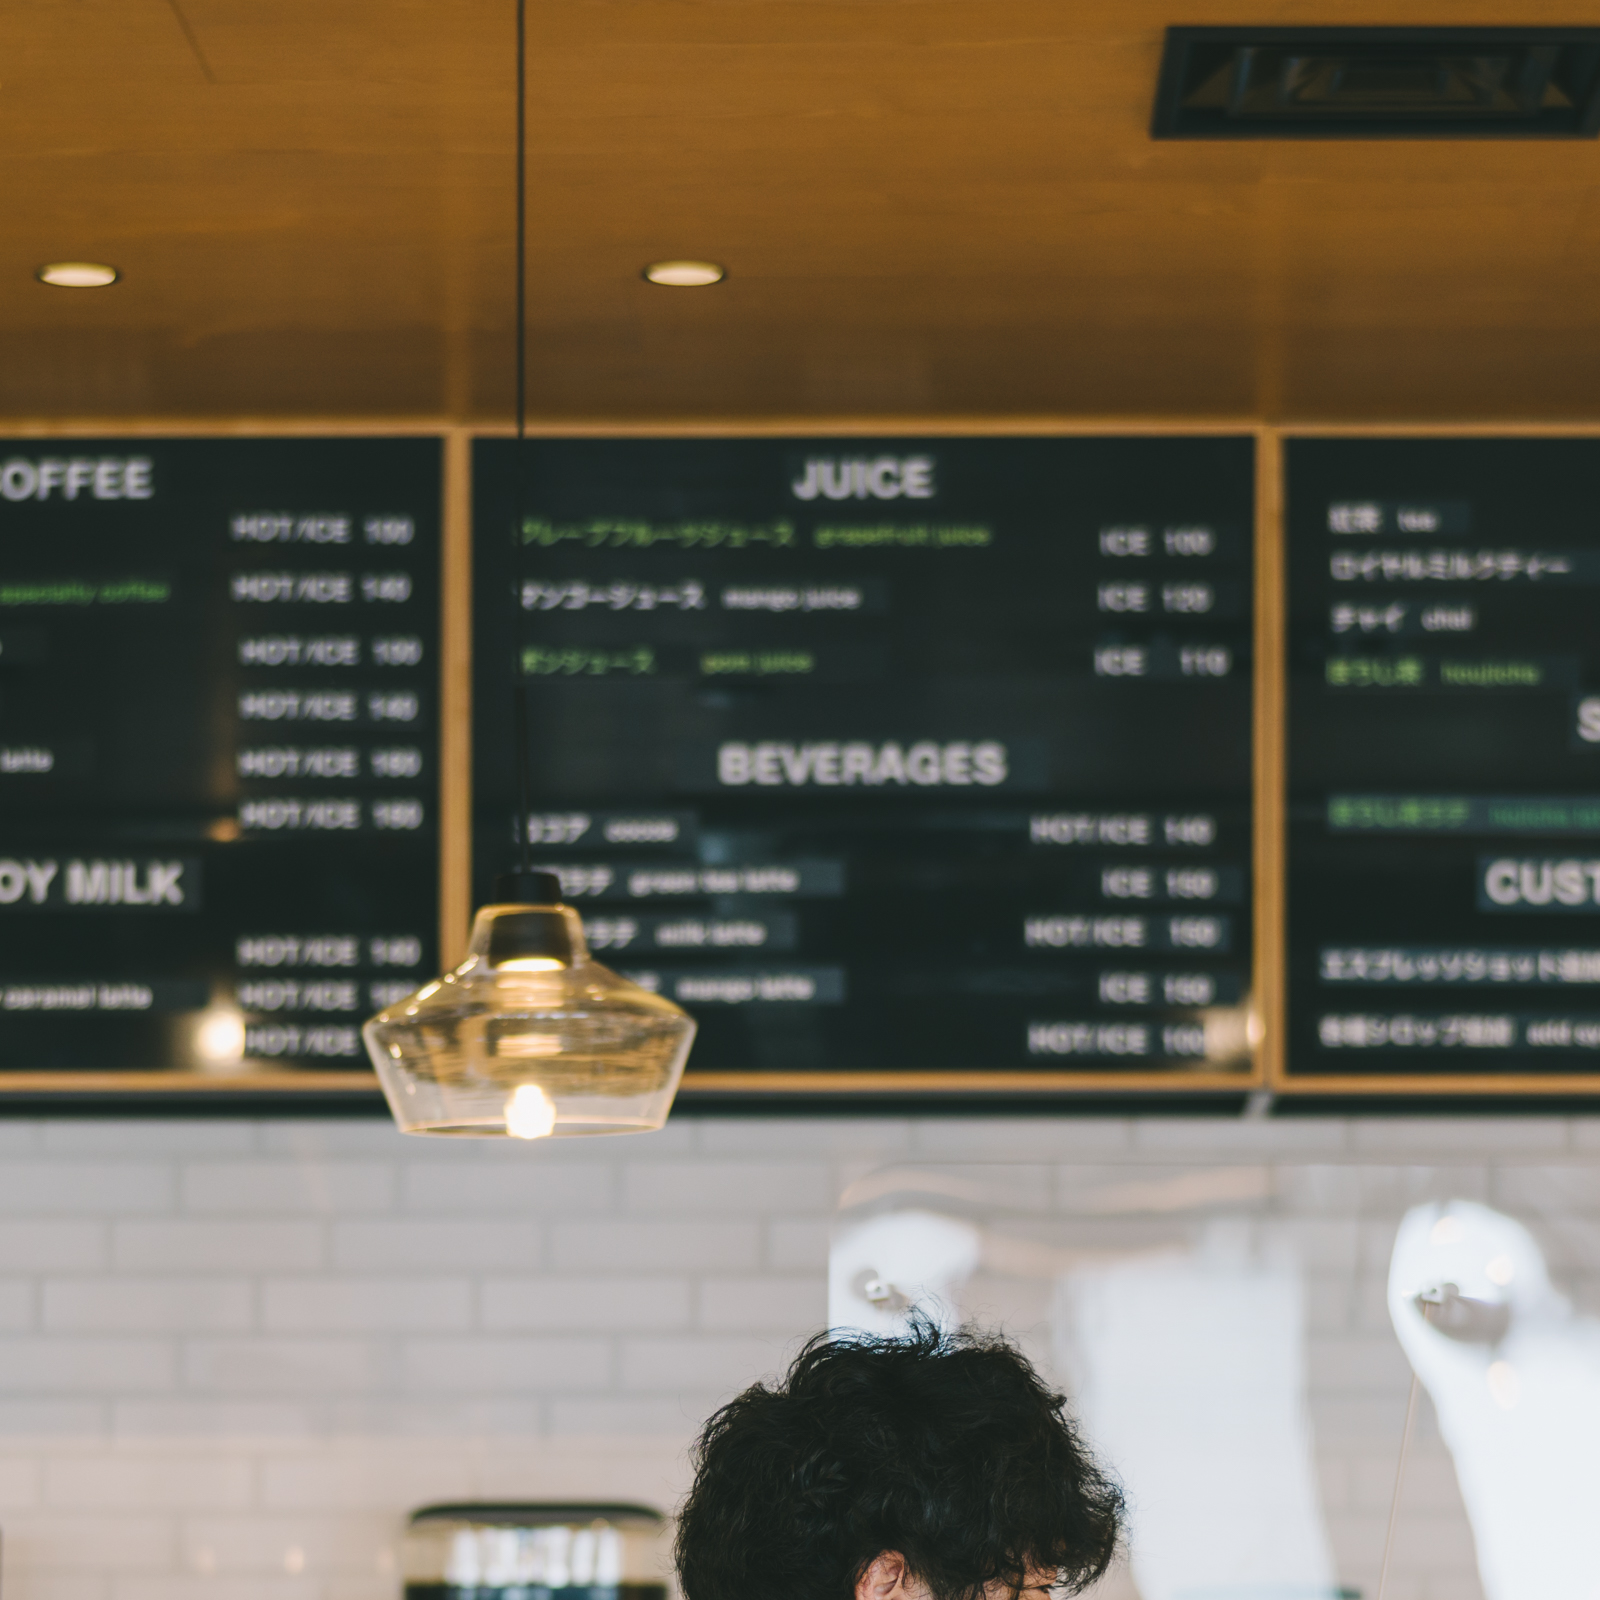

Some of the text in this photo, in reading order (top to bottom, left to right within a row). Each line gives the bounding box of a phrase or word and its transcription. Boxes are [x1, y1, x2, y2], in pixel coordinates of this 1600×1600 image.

[793, 457, 931, 499] JUICE
[233, 516, 349, 543] HOT/ICE
[1100, 529, 1148, 555] ICE
[233, 576, 349, 602] HOT/ICE
[1098, 585, 1146, 611] ICE
[241, 639, 357, 665] HOT/ICE
[1095, 649, 1143, 675] ICE
[240, 693, 354, 720] HOT/ICE
[238, 750, 356, 777] HOT/ICE
[718, 743, 1006, 785] BEVERAGES
[238, 801, 358, 829] HOT/ICE
[1030, 816, 1149, 844] HOT/ICE
[66, 862, 182, 904] MILK
[1102, 870, 1151, 897] ICE
[1025, 918, 1144, 946] HOT/ICE
[238, 938, 356, 966] HOT/ICE
[237, 982, 358, 1012] HOT/ICE
[1100, 975, 1149, 1003] ICE
[1028, 1025, 1147, 1054] HOT/ICE
